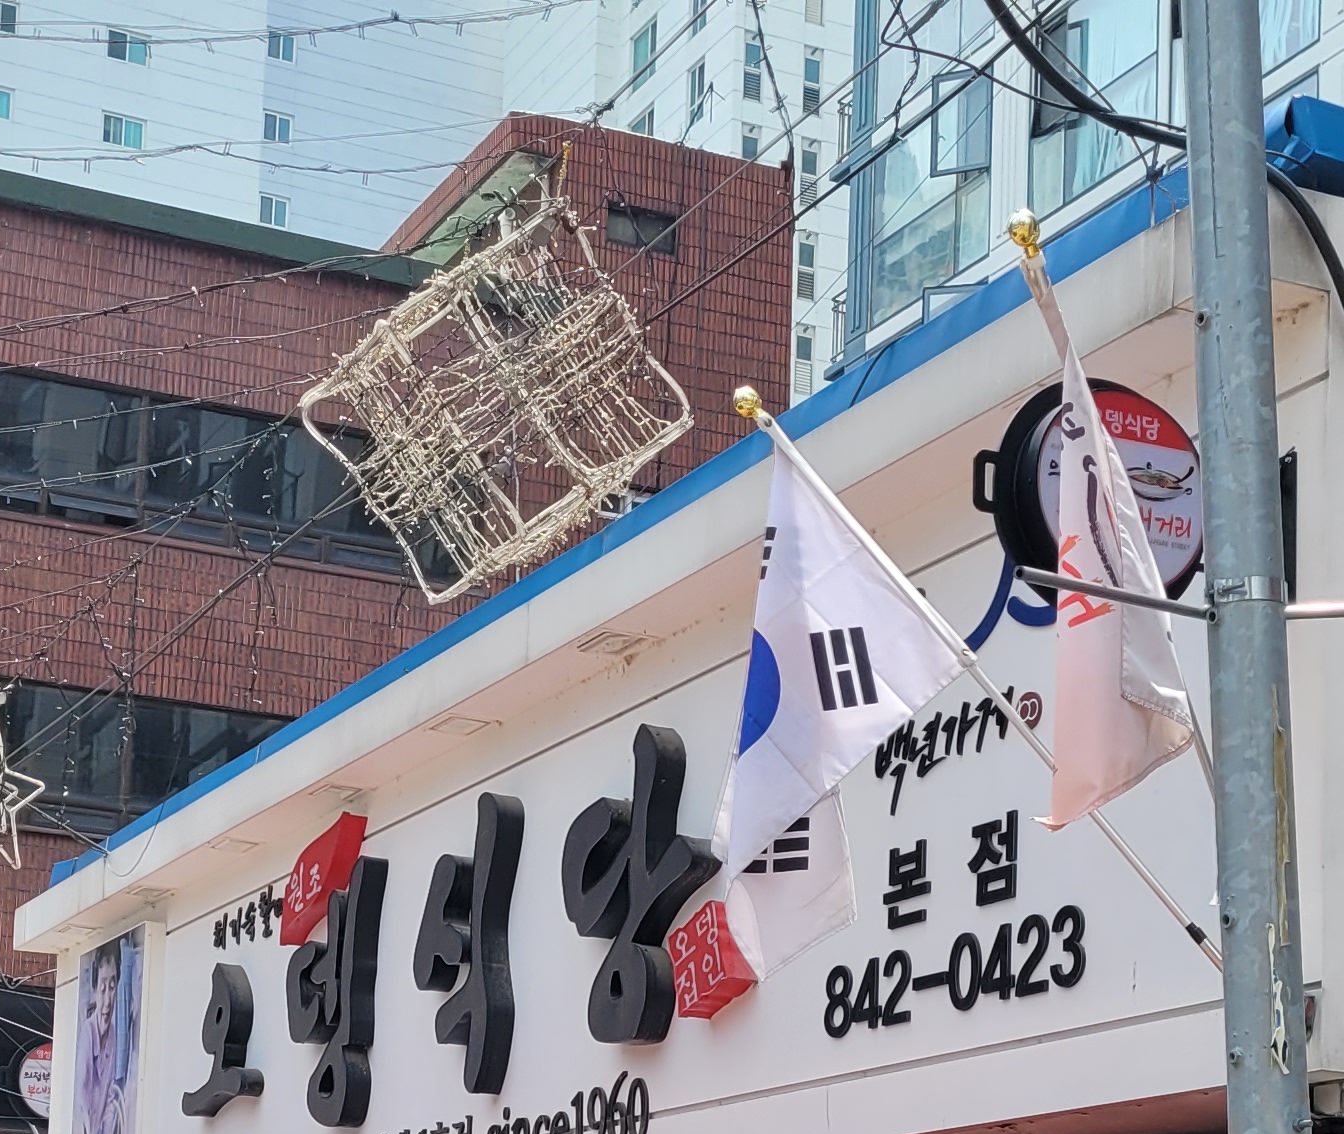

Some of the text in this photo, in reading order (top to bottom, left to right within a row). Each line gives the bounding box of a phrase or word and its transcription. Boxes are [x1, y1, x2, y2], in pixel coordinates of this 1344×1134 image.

[1097, 408, 1161, 441] 뎅식당
[182, 723, 723, 1127] 오뎅식당
[882, 809, 1019, 930] 본점
[824, 904, 1087, 1039] 842-0423
